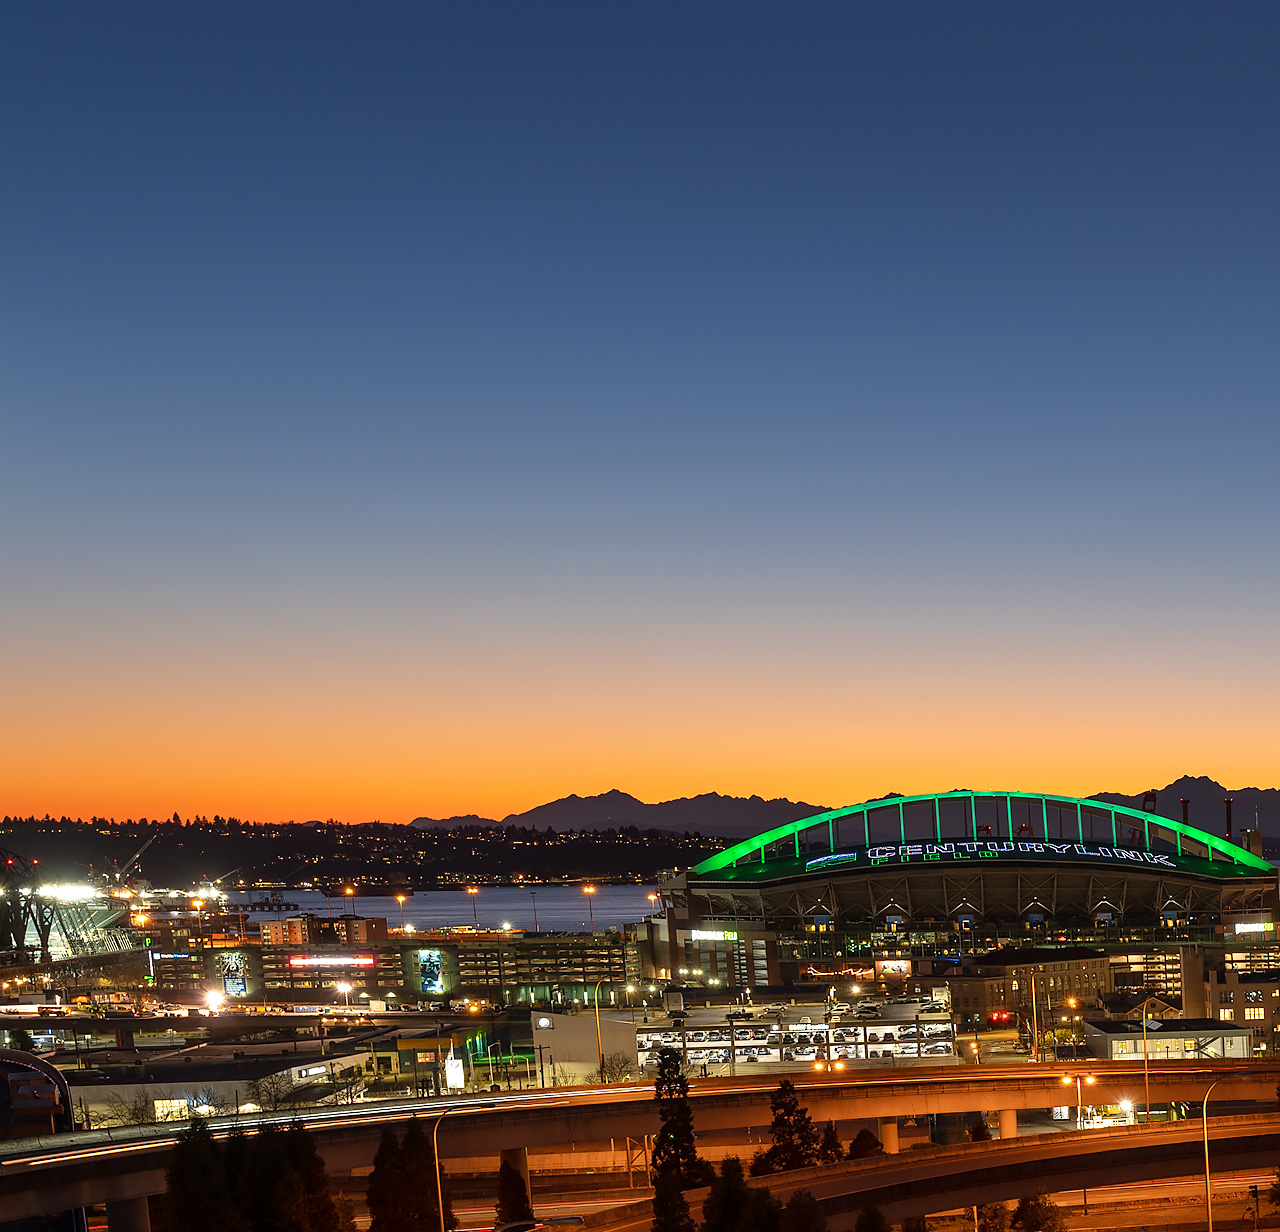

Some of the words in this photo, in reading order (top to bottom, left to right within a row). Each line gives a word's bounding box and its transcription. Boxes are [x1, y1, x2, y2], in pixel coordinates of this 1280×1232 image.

[867, 841, 1177, 868] CENTURYLINK
[870, 850, 998, 866] FIELD
[146, 938, 151, 947] P
